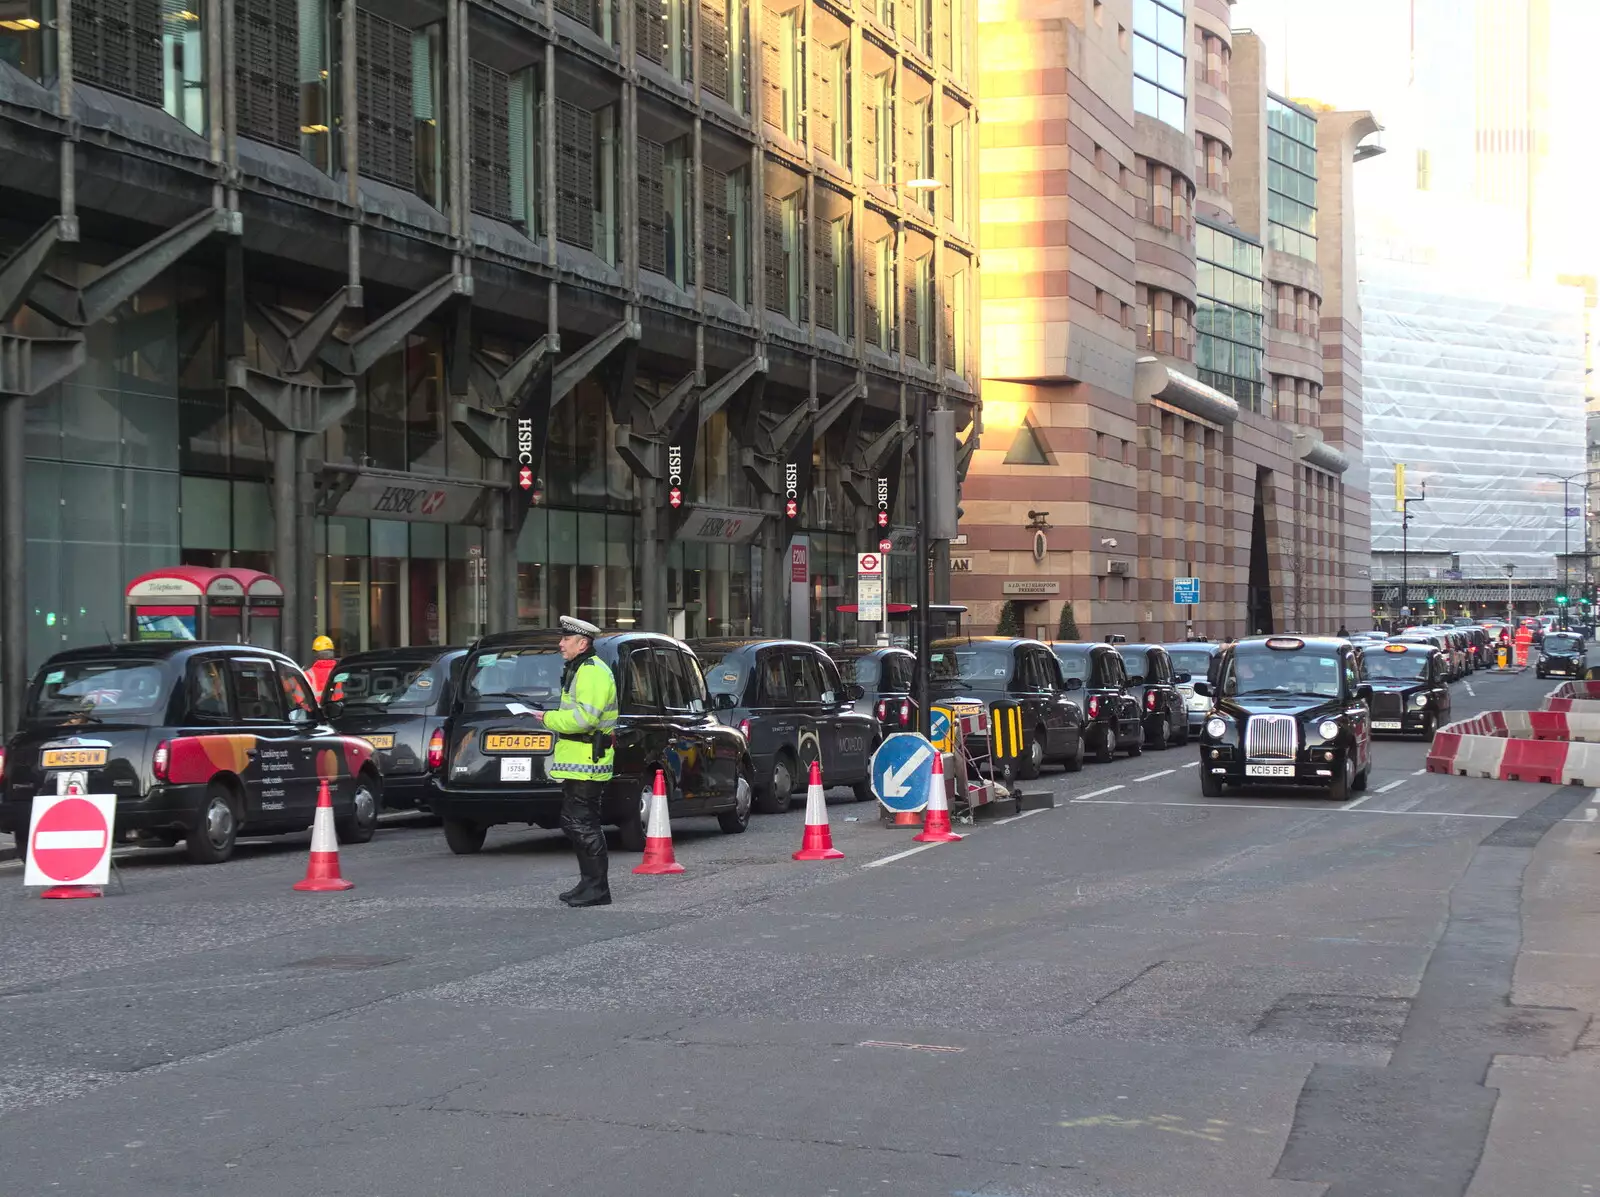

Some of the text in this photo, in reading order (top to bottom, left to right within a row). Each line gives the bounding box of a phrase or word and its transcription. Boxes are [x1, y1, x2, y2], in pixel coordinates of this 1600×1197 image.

[518, 418, 533, 465] HSBC
[669, 445, 682, 486] HSBC
[786, 462, 798, 499] HSBC
[373, 486, 427, 513] HSBC
[877, 477, 889, 510] HSBC
[792, 549, 806, 565] £200
[492, 737, 546, 747] LF04 GFE
[1251, 766, 1290, 775] KC15 BFE
